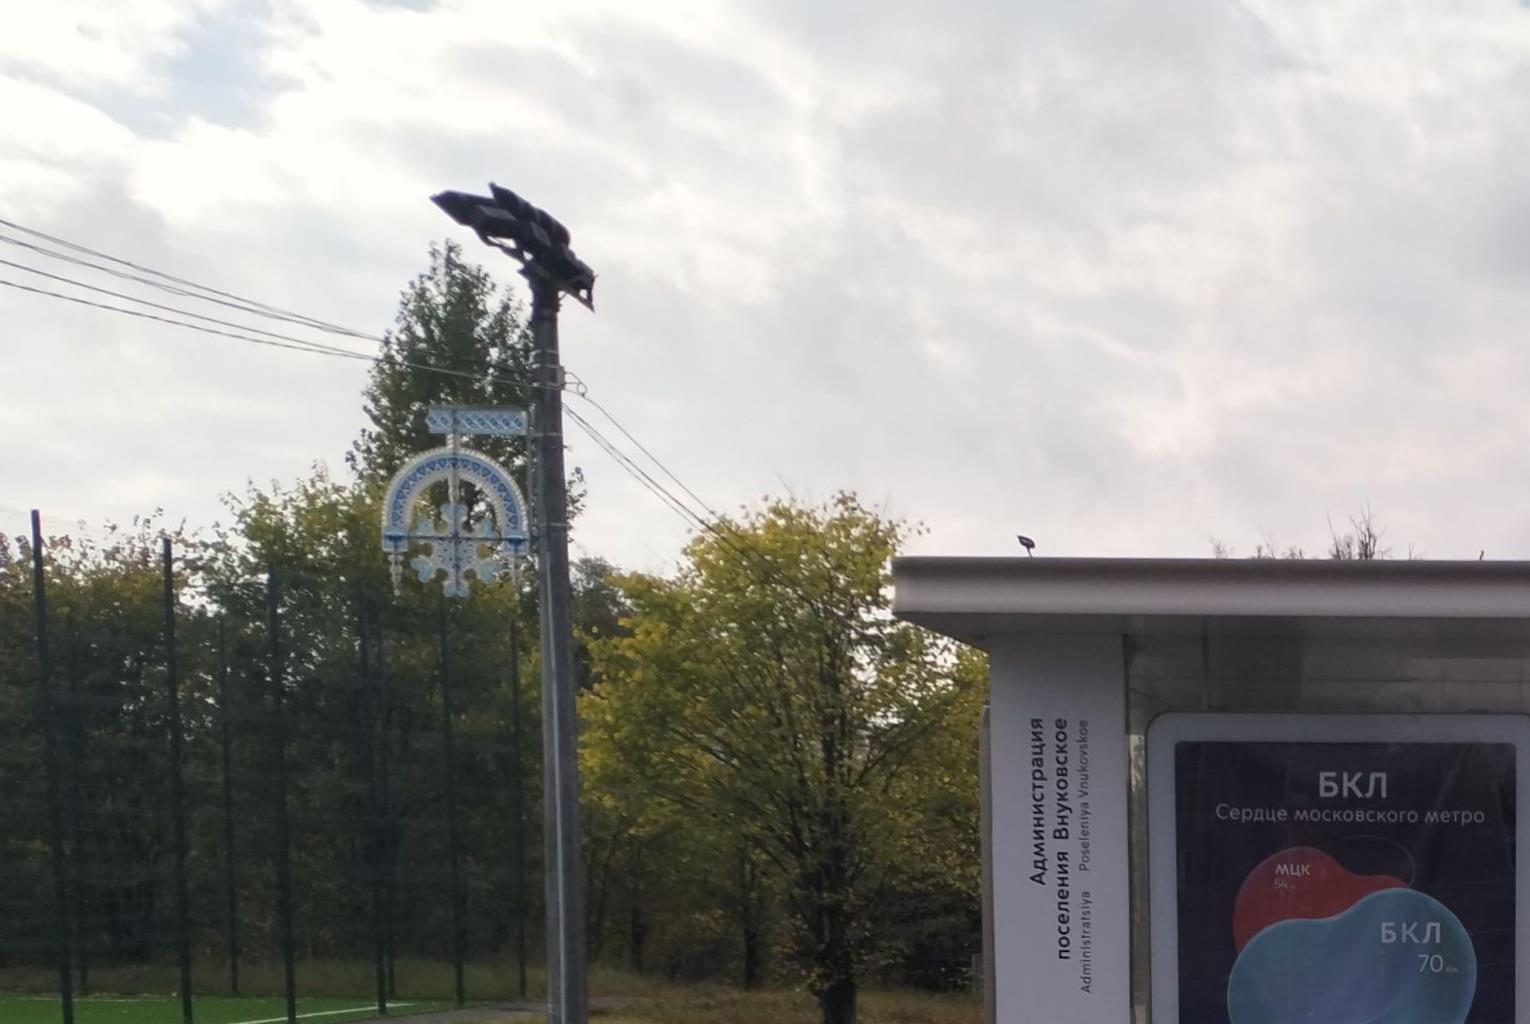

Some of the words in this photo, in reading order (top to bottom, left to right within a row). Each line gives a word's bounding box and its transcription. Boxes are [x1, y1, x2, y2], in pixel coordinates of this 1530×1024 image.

[1053, 717, 1073, 840] Внуковское
[1077, 719, 1090, 799] Vnukovskoe
[1318, 771, 1388, 799] БКЛ
[1029, 717, 1048, 885] Администрация
[1078, 801, 1093, 872] Poseleniya
[1215, 803, 1289, 824] Сердце
[1294, 808, 1419, 823] московского
[1425, 811, 1486, 827] метро
[1274, 862, 1312, 877] МЦК
[1056, 851, 1071, 960] поселения
[1380, 921, 1441, 944] БКЛ
[1079, 890, 1094, 994] Administratsiya
[1418, 954, 1444, 973] 70
